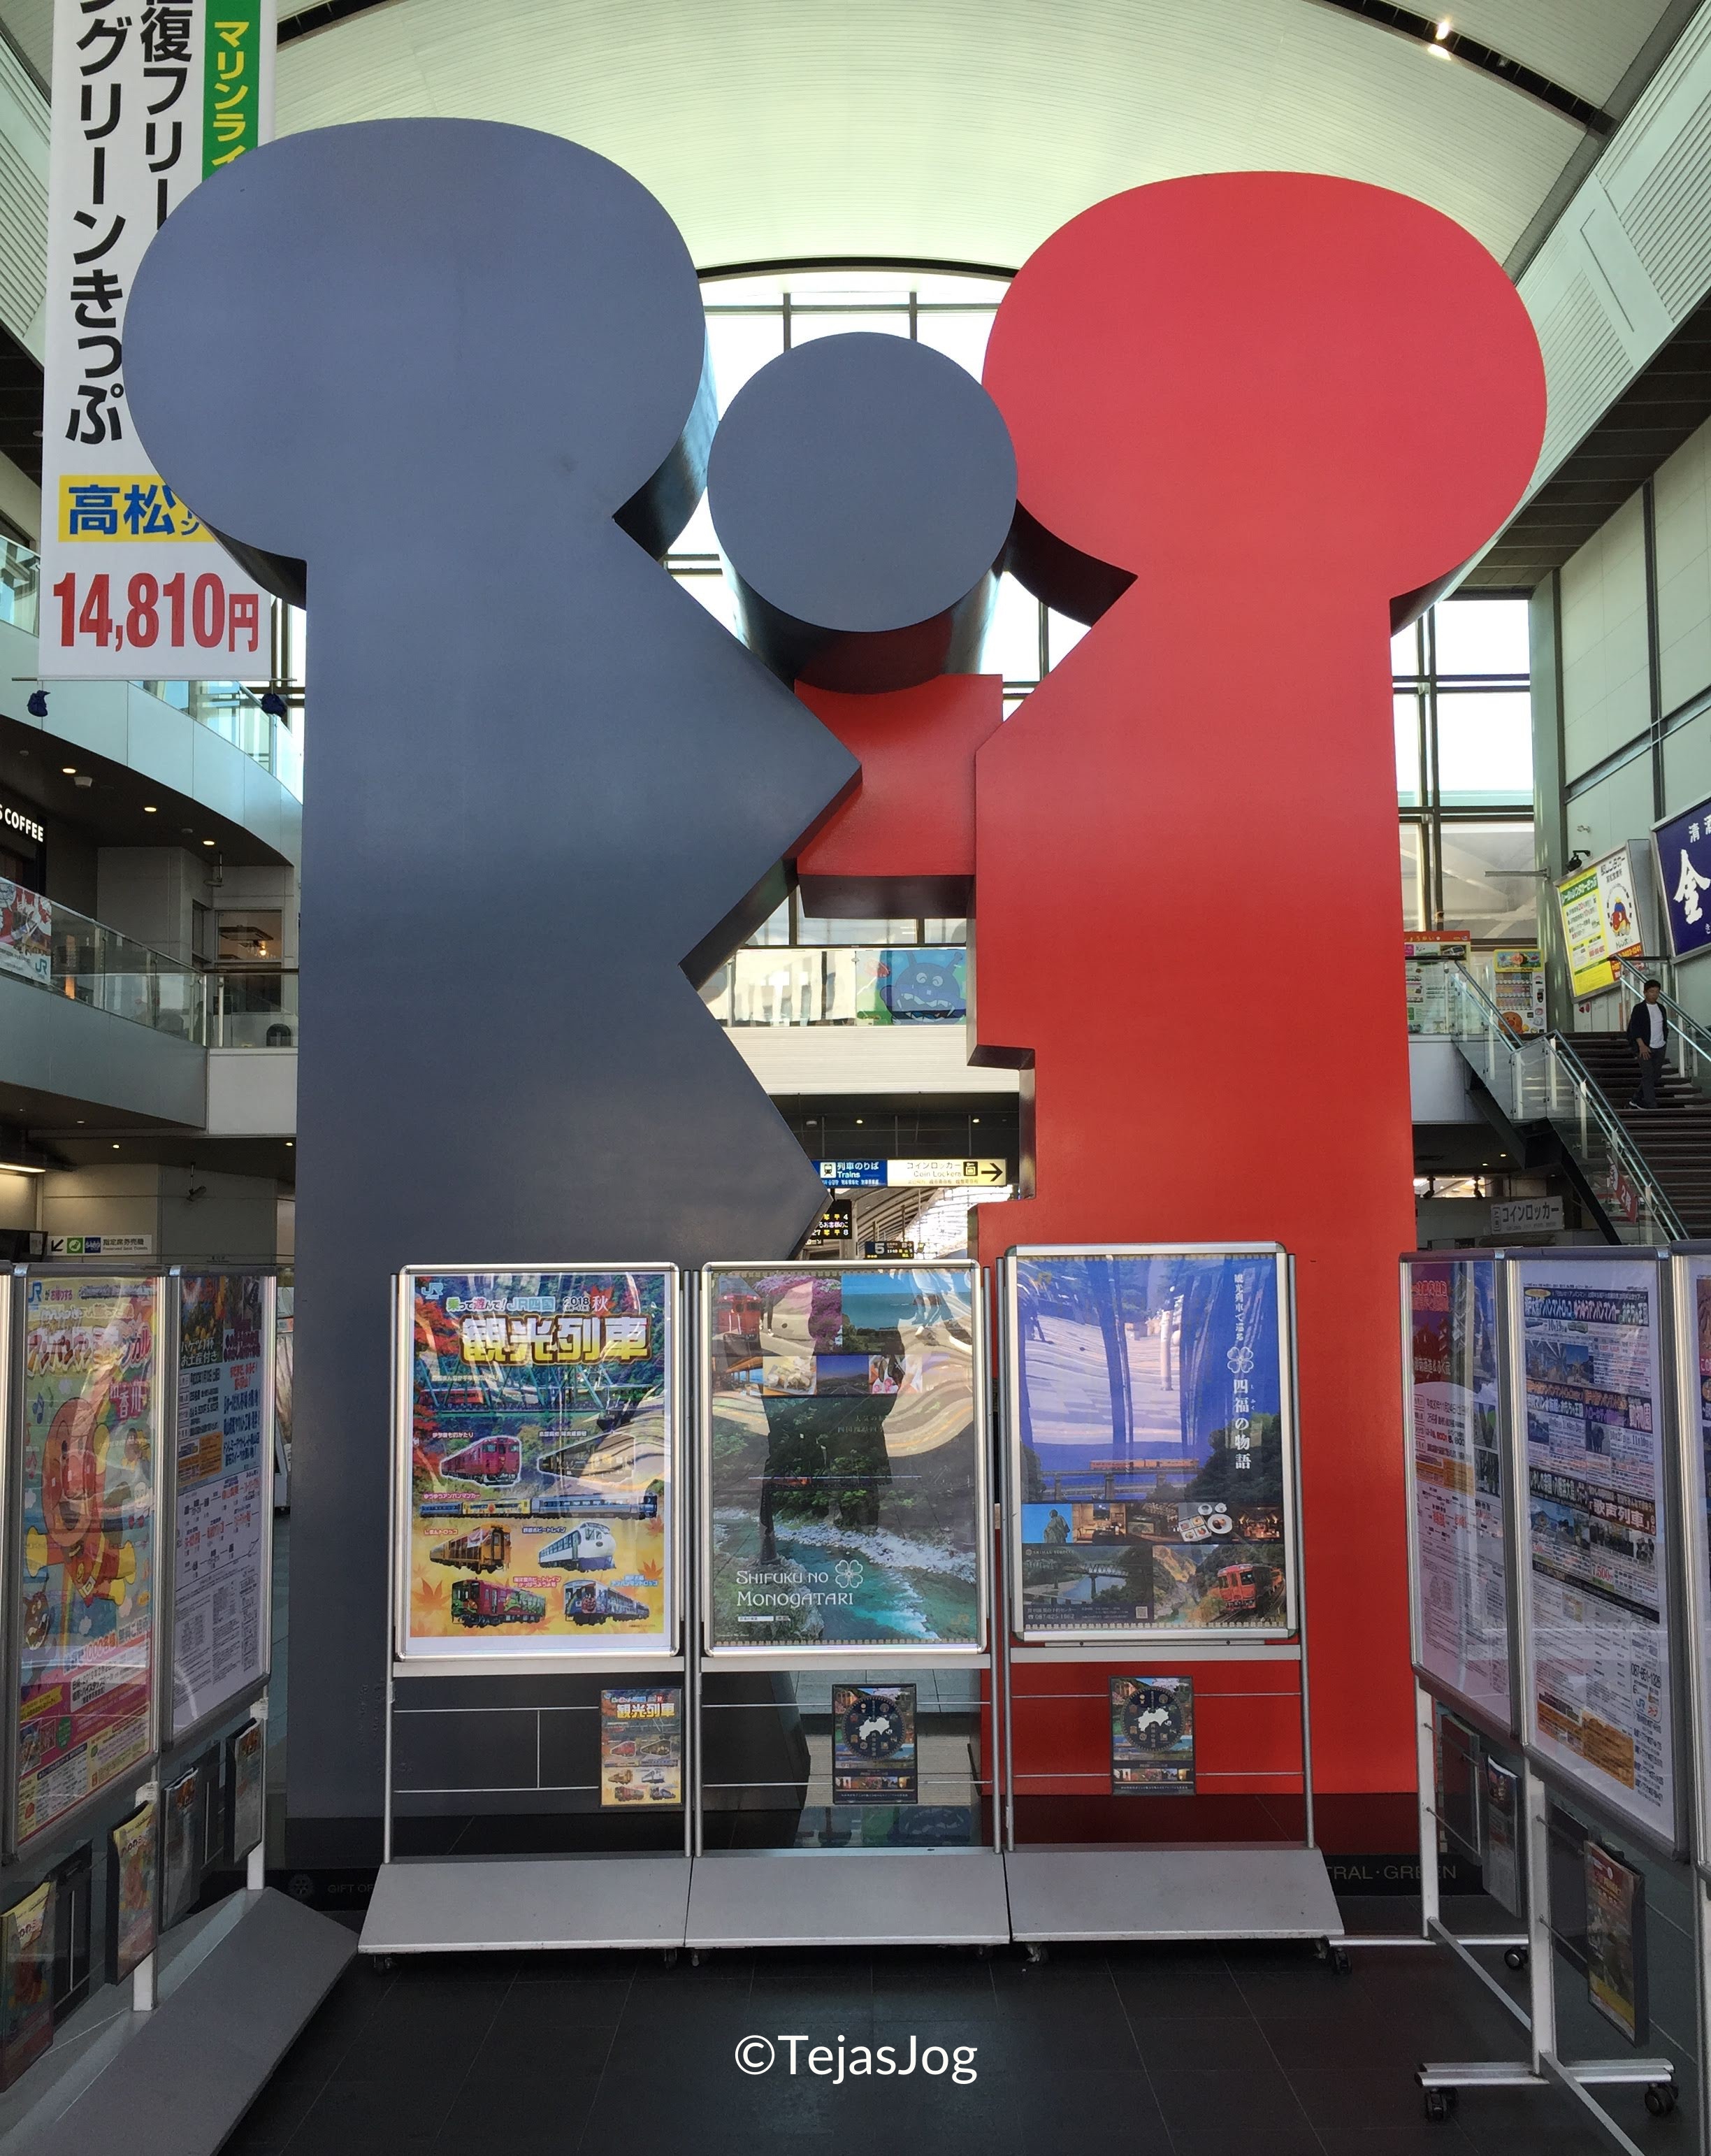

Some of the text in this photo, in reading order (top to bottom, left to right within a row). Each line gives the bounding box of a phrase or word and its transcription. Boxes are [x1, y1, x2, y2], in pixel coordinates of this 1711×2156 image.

[64, 0, 133, 445] グリーンきっぷ
[68, 484, 176, 535] 高松
[53, 572, 259, 652] 14,810円
[4, 807, 43, 842] COFFEE
[35, 958, 48, 975] JR
[837, 1161, 879, 1170] 列車のりば
[907, 1161, 961, 1170] コインロッカー
[1502, 1202, 1559, 1223] コインロッカー
[874, 1242, 885, 1254] 5
[28, 1281, 43, 1302] JR
[421, 1282, 444, 1296] JR
[507, 1296, 556, 1312] JR四国
[563, 1297, 590, 1306] 2018
[591, 1295, 610, 1312] 秋
[1234, 1274, 1245, 1341] 観光列車で巡る
[462, 1316, 648, 1362] 観光列車
[181, 1351, 217, 1367] お土産付き
[1233, 1379, 1252, 1470] 四福の物語
[616, 1702, 675, 1719] 観光列車
[328, 1884, 354, 1893] GIFT
